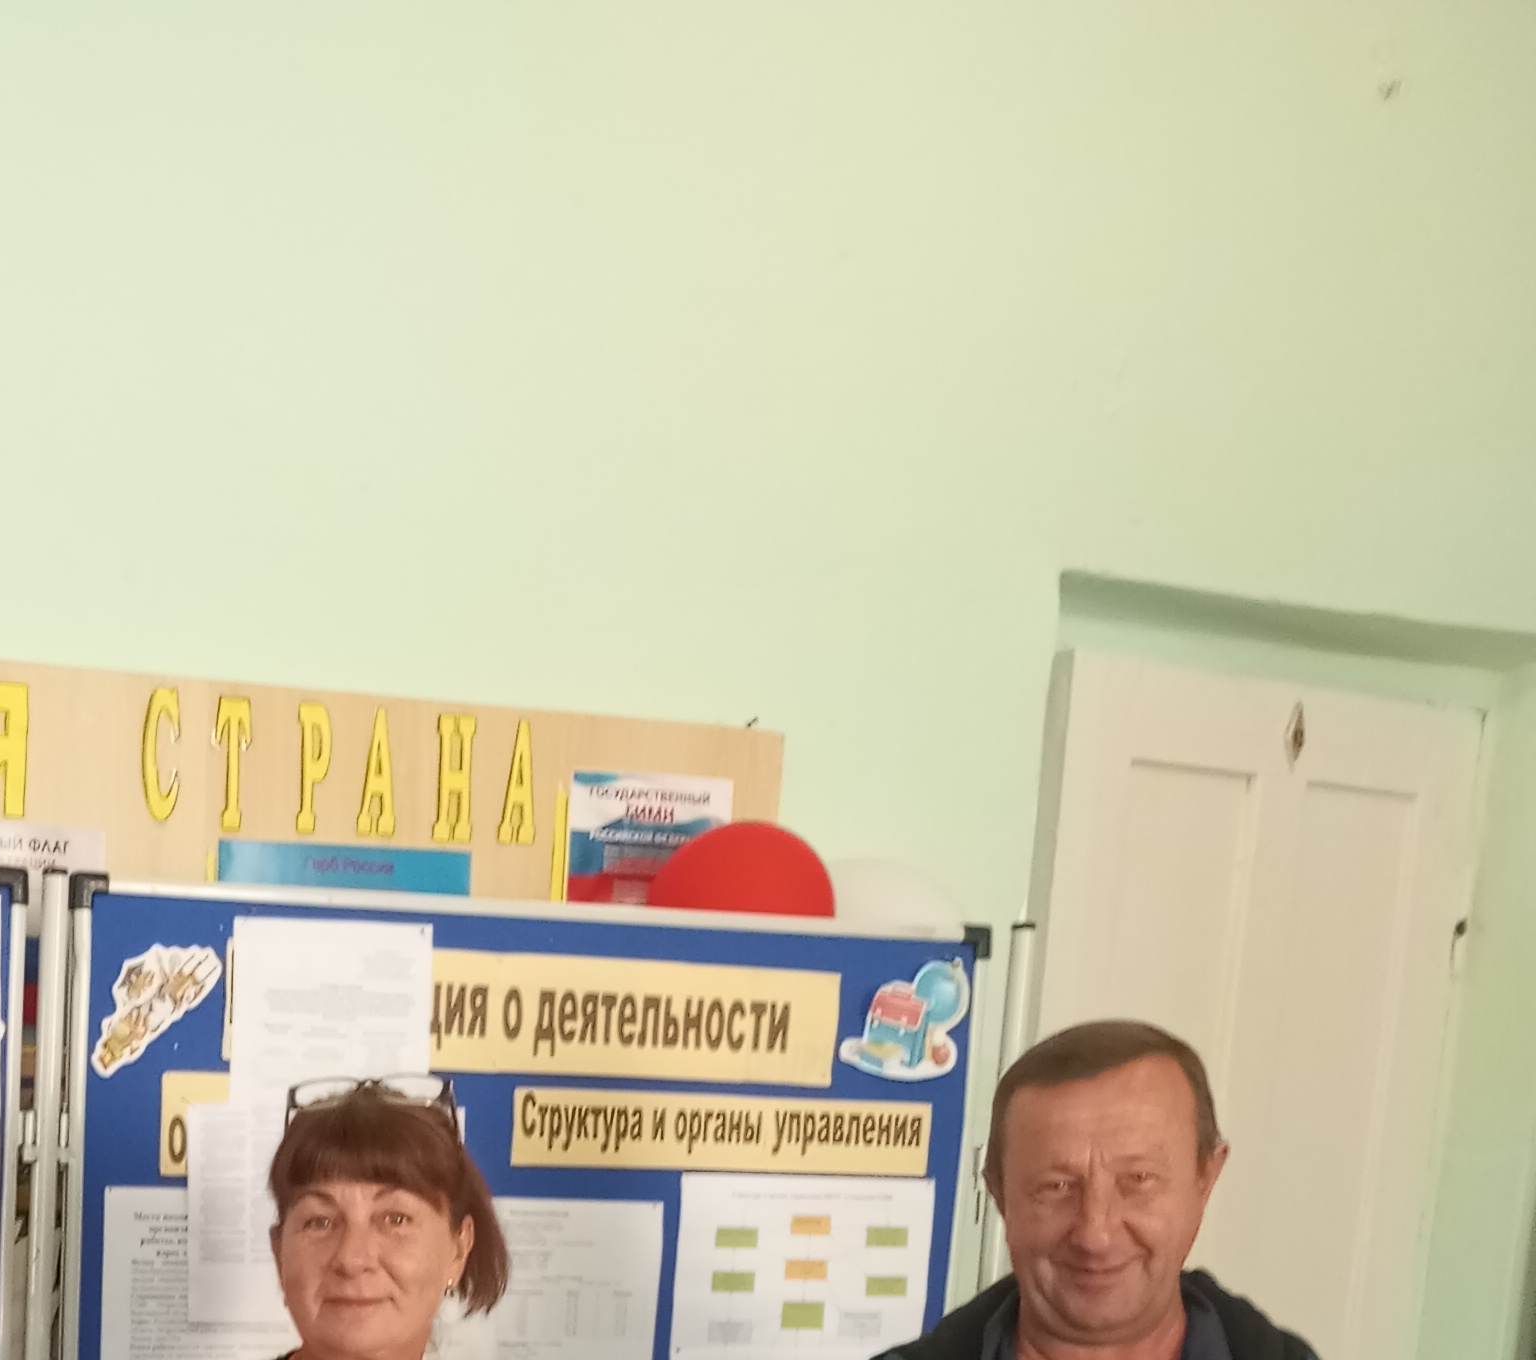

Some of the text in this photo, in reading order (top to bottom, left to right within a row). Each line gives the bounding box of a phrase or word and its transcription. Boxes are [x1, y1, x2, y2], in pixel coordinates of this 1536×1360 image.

[141, 686, 535, 845] СТРАНА
[589, 784, 712, 806] ГОСУДАРСТВЕННЫЙ
[27, 838, 70, 854] ФЛАГ
[430, 981, 489, 1050] ция
[503, 985, 522, 1040] о
[532, 988, 792, 1057] деятельности
[521, 1090, 922, 1156] Структура и органы управления
